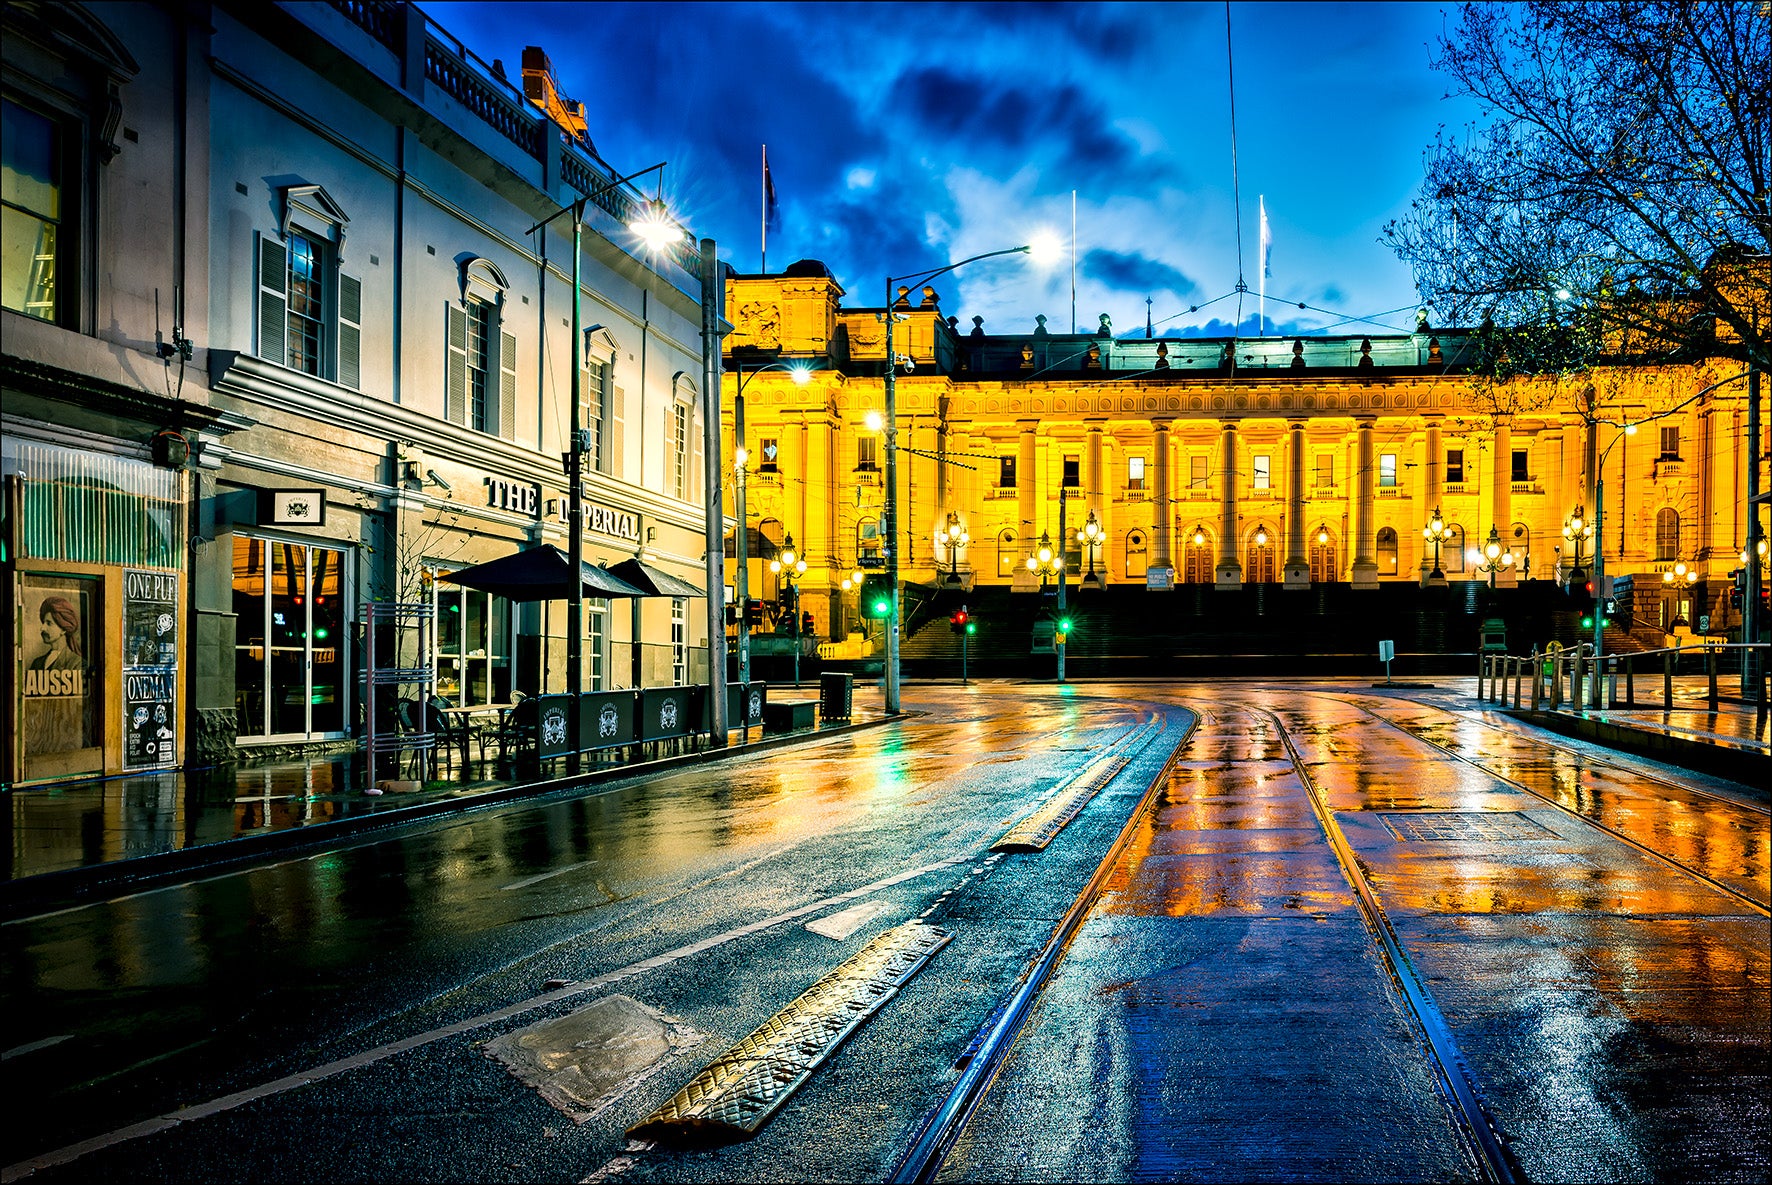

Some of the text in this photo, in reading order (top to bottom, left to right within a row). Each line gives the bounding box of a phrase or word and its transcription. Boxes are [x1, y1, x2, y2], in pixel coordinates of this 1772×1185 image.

[485, 477, 641, 542] THE IPERIAL
[128, 573, 151, 599] ONE
[127, 676, 173, 699] ONEMAN
